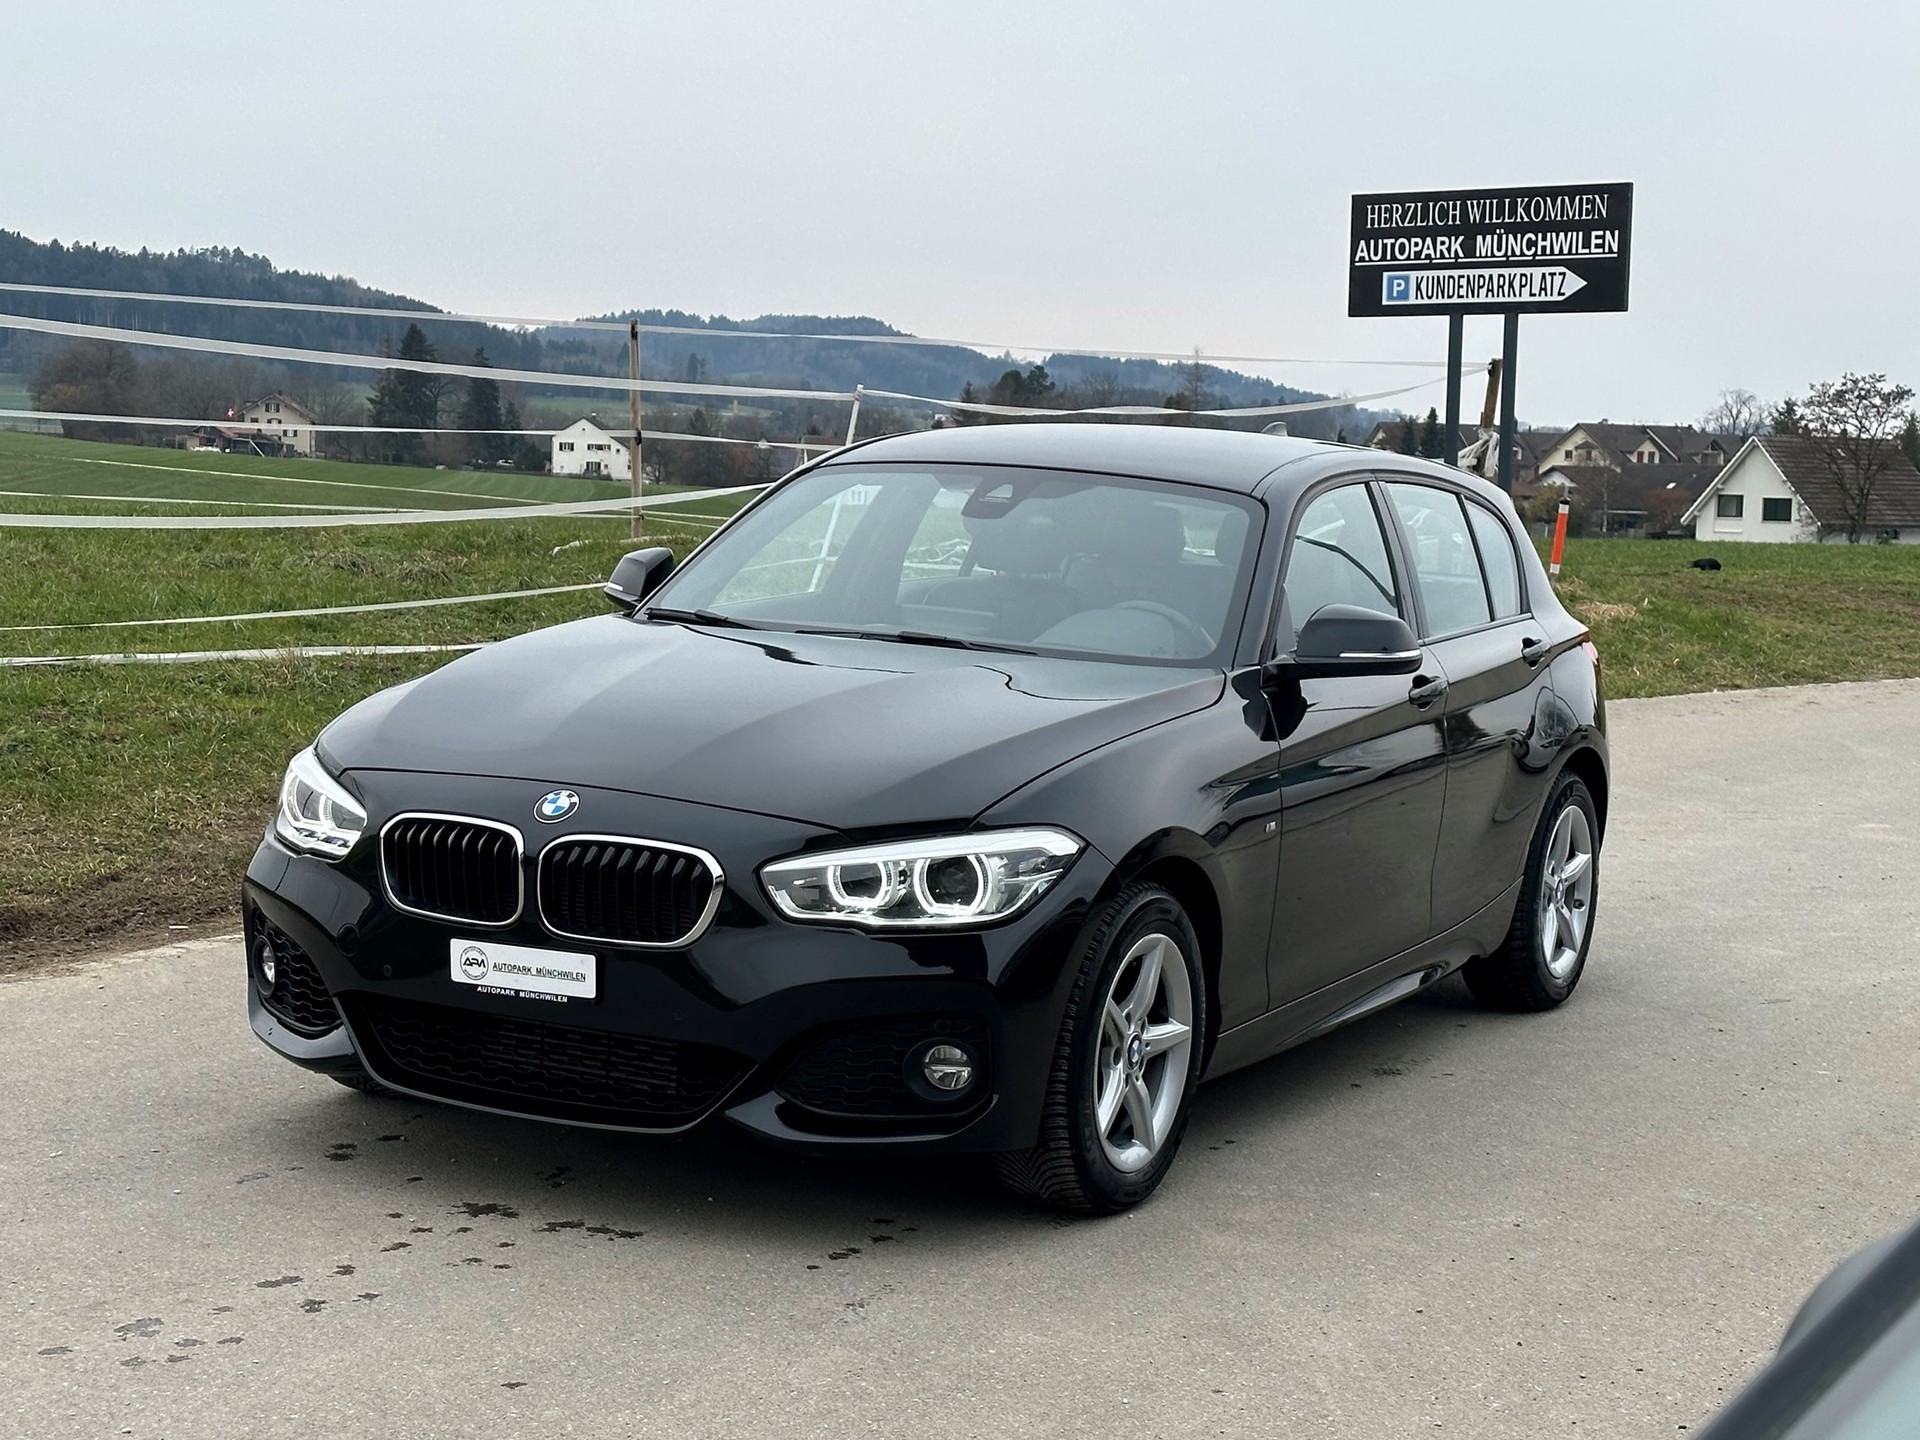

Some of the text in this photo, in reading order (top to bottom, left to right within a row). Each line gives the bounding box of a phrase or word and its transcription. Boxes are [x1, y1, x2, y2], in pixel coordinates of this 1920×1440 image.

[1366, 194, 1609, 229] HERZLICH WILLKOMMEN
[1355, 229, 1619, 262] AUTOPARK MÜNCHWILEN
[1392, 272, 1567, 300] P KUNDENPARKPLATZ
[492, 962, 532, 974] AUTOPARK
[536, 967, 586, 981] MÜNCHWILEN
[476, 986, 568, 1003] AUTOPARK MÜNCHWILEN
